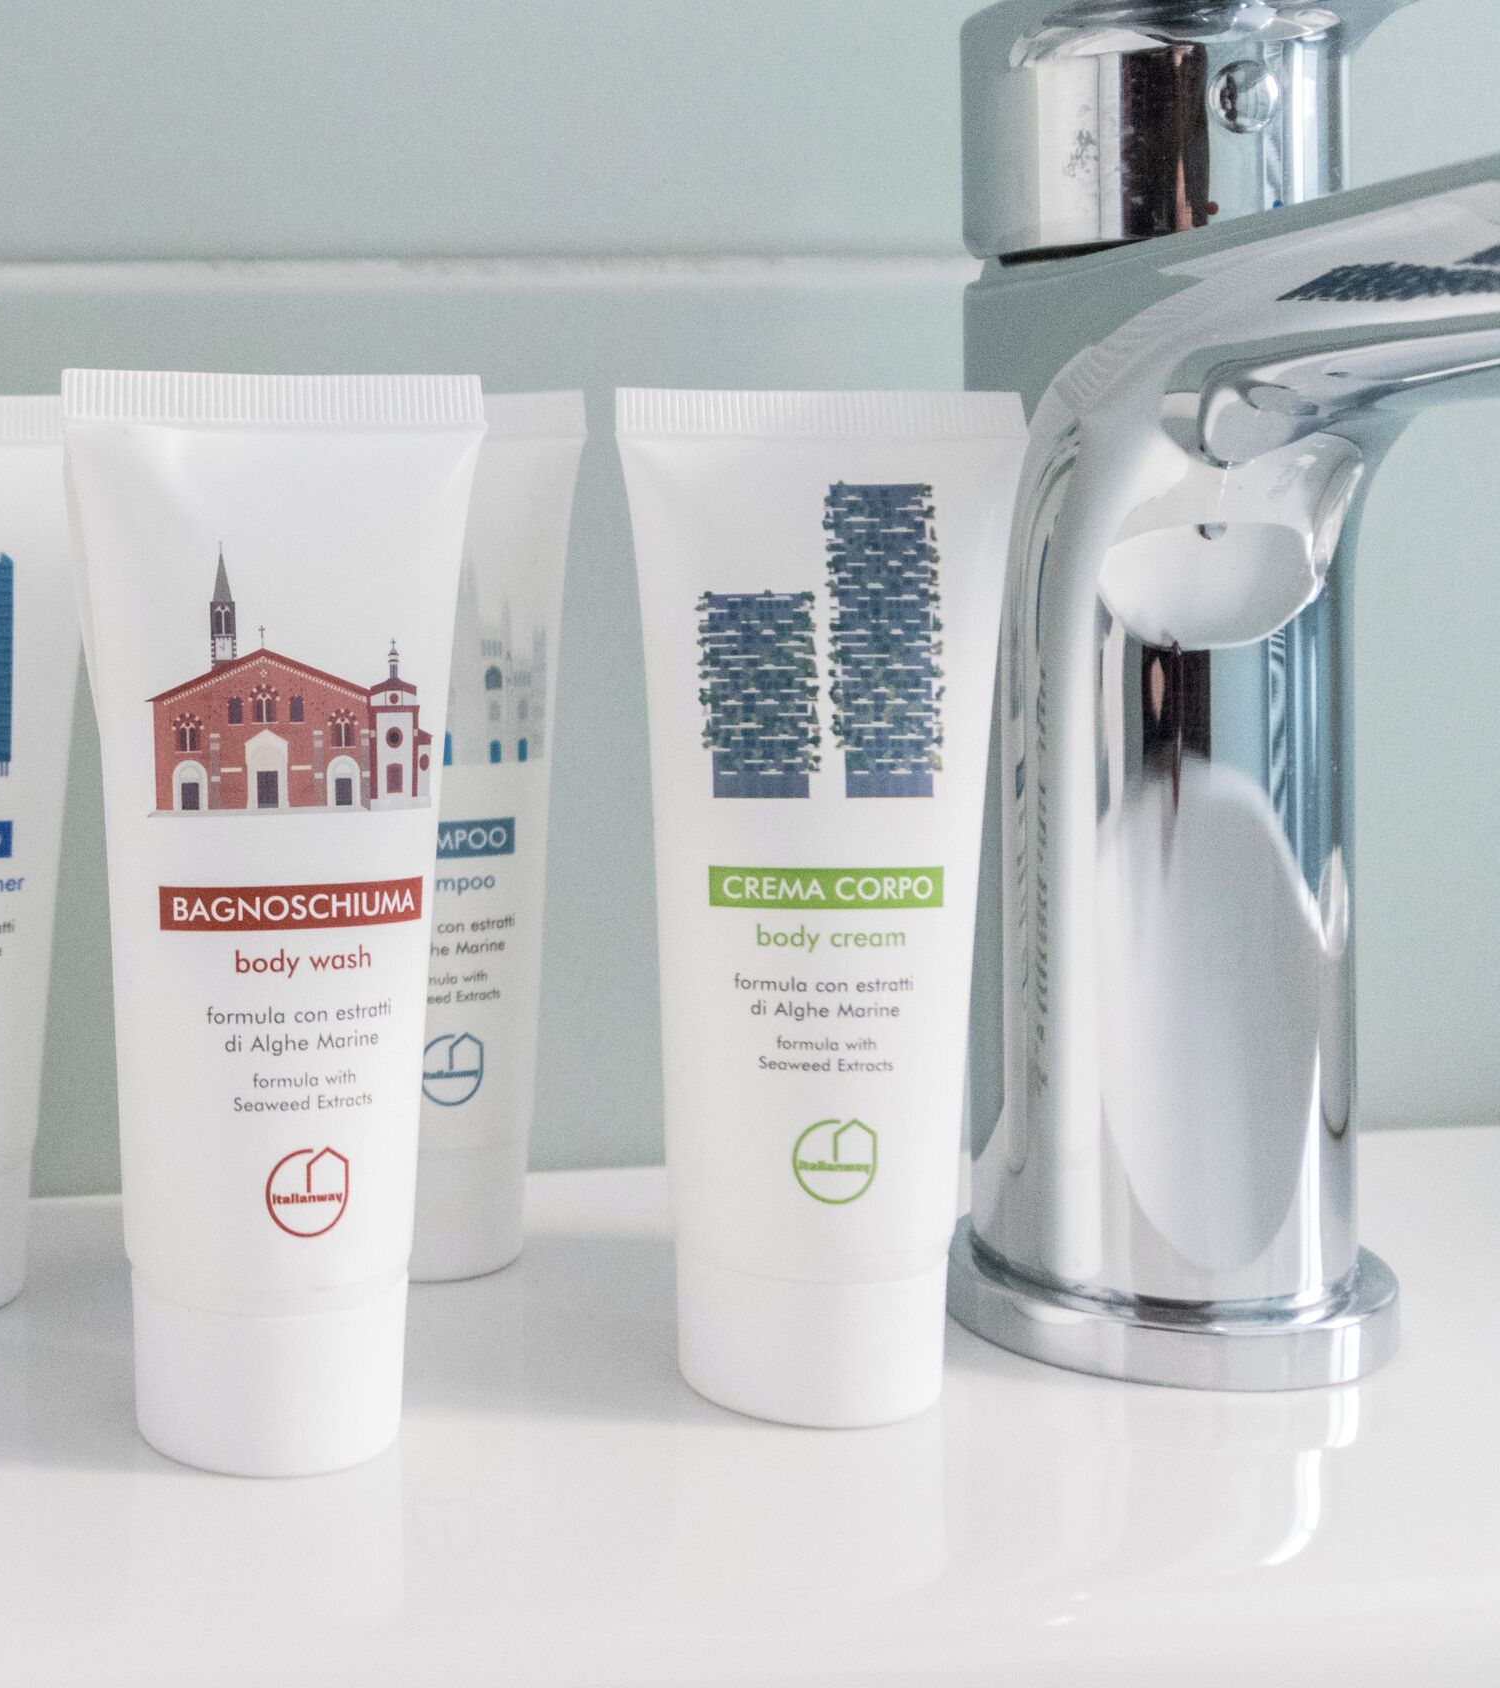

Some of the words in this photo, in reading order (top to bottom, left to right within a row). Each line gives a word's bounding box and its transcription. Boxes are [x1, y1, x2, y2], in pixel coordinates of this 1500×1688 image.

[438, 827, 507, 850] MPOO
[436, 875, 496, 896] mpoo
[722, 875, 827, 901] CREMA
[834, 876, 934, 901] CORPO
[172, 889, 415, 922] BAGNOSCHIUMA
[437, 923, 465, 934] con
[471, 913, 516, 932] estratti
[456, 939, 506, 956] Marine
[756, 923, 821, 953] body
[830, 928, 907, 948] cream
[234, 948, 301, 979] body
[310, 945, 373, 970] wash
[463, 970, 489, 984] with
[734, 973, 808, 993] formula
[815, 981, 849, 994] con
[856, 976, 915, 993] estratti
[457, 988, 501, 1003] Extracts
[206, 1006, 285, 1026] formula
[294, 1009, 328, 1024] con
[336, 999, 393, 1022] estratti
[750, 1000, 767, 1017] di
[774, 1002, 830, 1022] Alghe
[837, 1001, 900, 1018] Marine
[224, 1034, 242, 1053] di
[250, 1034, 309, 1057] Alghe
[317, 1032, 380, 1051] Marine
[776, 1035, 840, 1052] formula
[845, 1036, 877, 1051] with
[758, 1056, 832, 1073] Seaweed
[838, 1058, 895, 1073] Extracts
[252, 1073, 319, 1089] formula
[325, 1069, 357, 1086] with
[233, 1096, 311, 1113] Seaweed
[317, 1092, 373, 1109] Extracts
